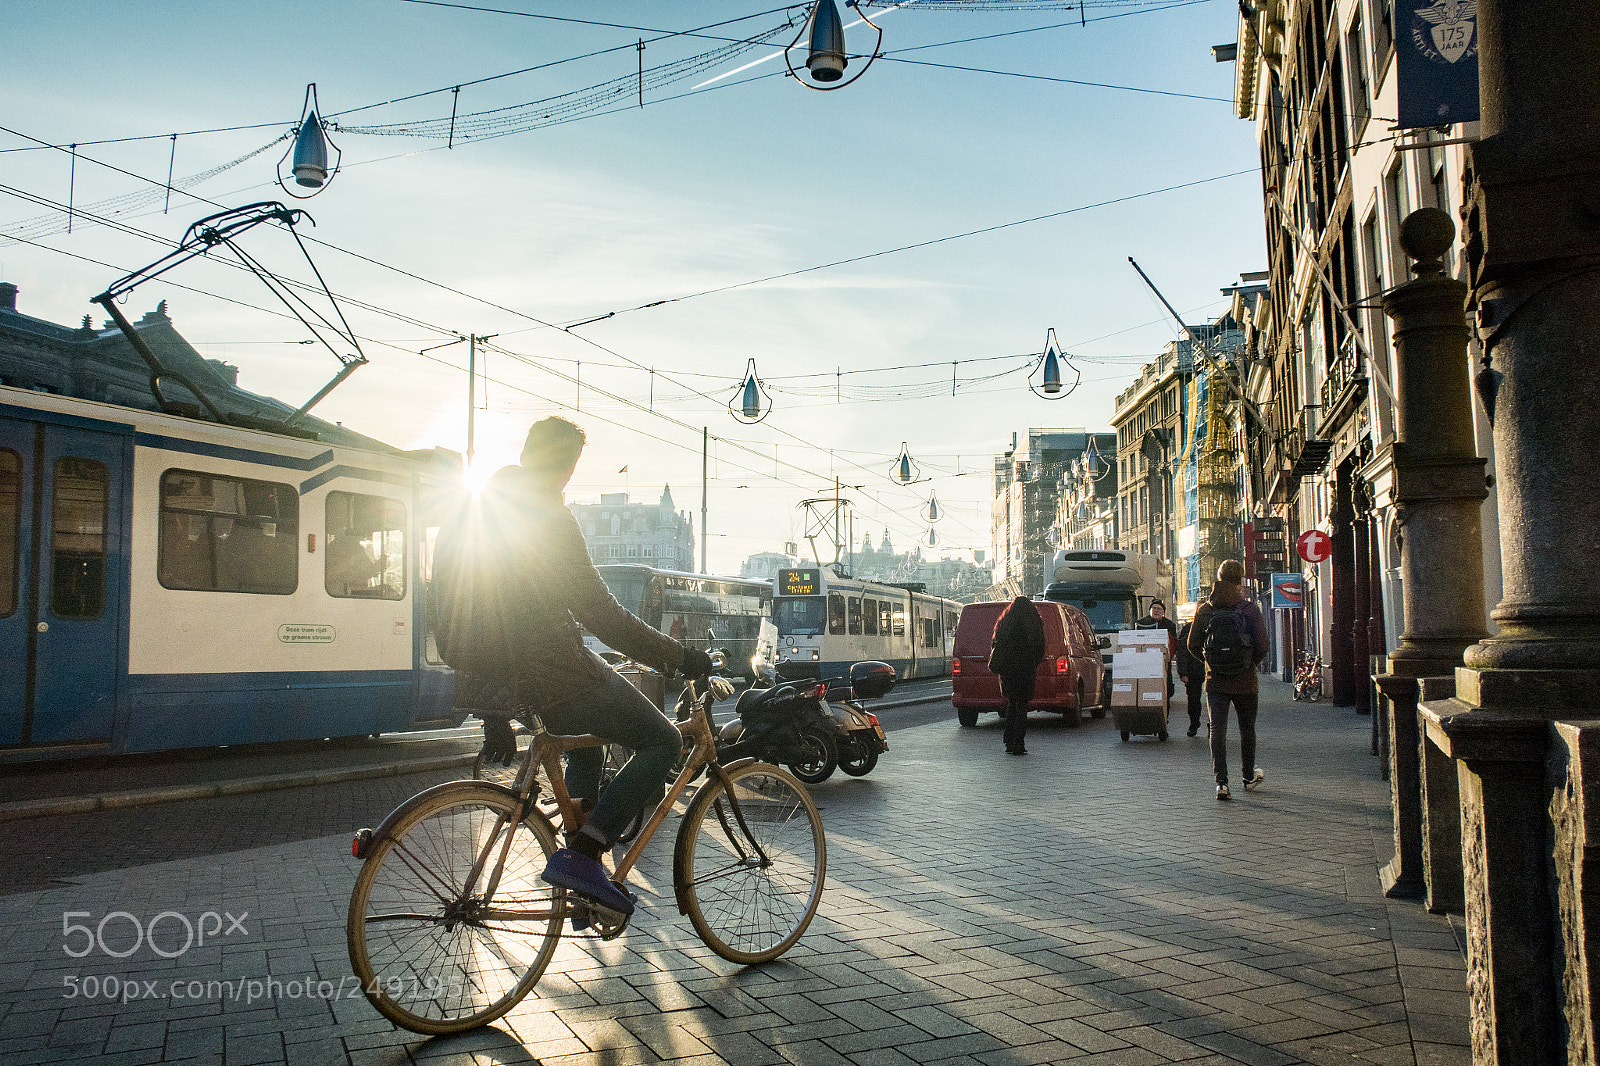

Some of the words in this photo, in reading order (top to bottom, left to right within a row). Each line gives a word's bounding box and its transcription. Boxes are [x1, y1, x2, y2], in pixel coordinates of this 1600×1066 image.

[1411, 28, 1426, 50] ARTI
[1440, 26, 1465, 42] 175
[1441, 41, 1464, 50] JAAR
[1303, 531, 1323, 562] t
[788, 572, 800, 582] 24
